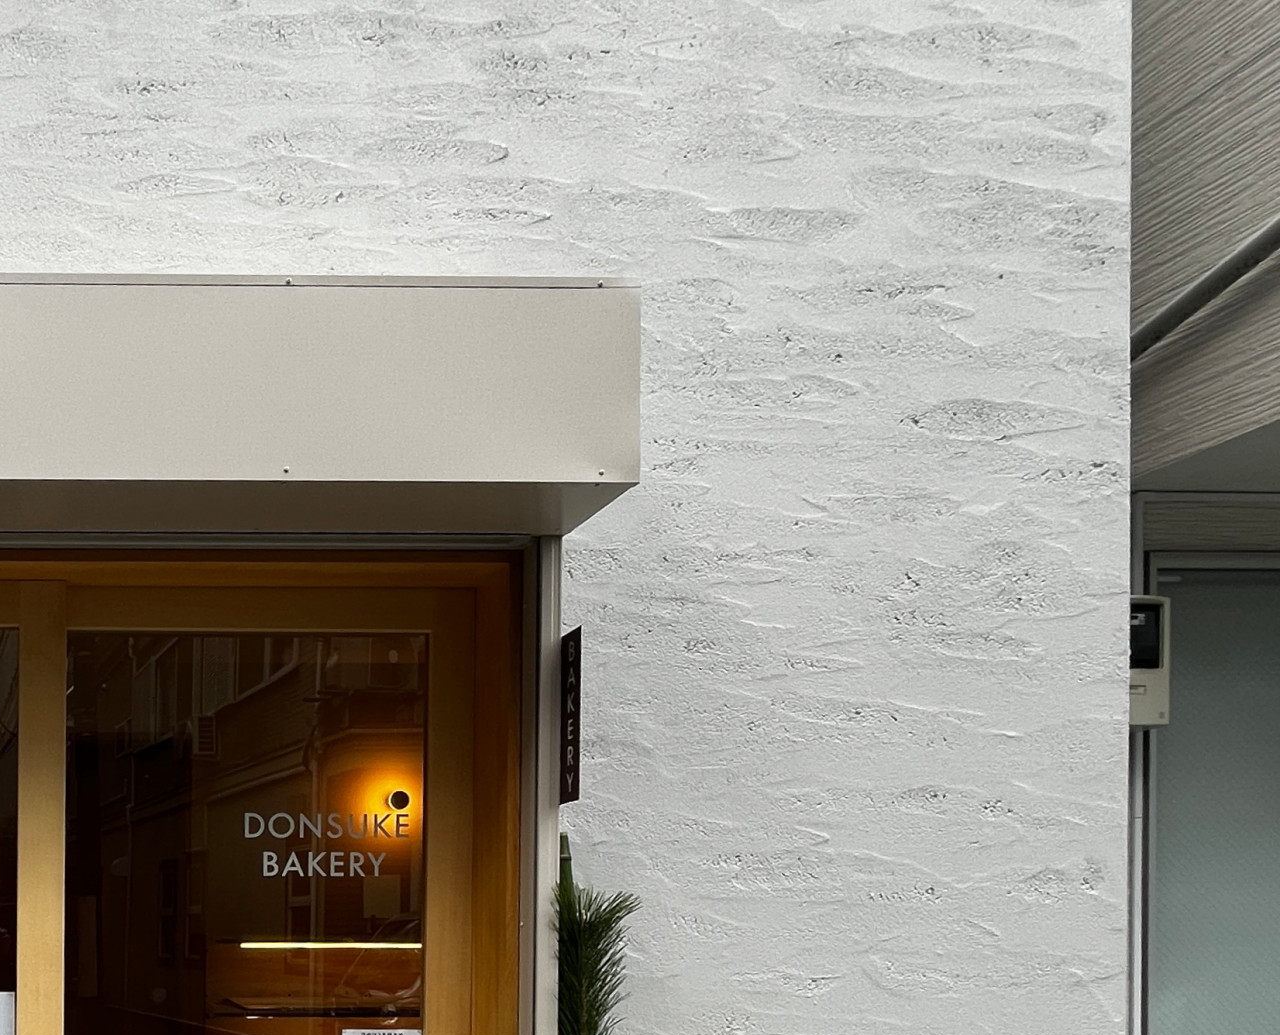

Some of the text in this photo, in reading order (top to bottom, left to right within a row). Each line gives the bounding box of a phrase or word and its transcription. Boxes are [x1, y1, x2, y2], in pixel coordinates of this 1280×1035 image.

[566, 641, 576, 793] BAKERY
[243, 812, 410, 839] DONSUKE
[262, 851, 386, 877] BAKERY
